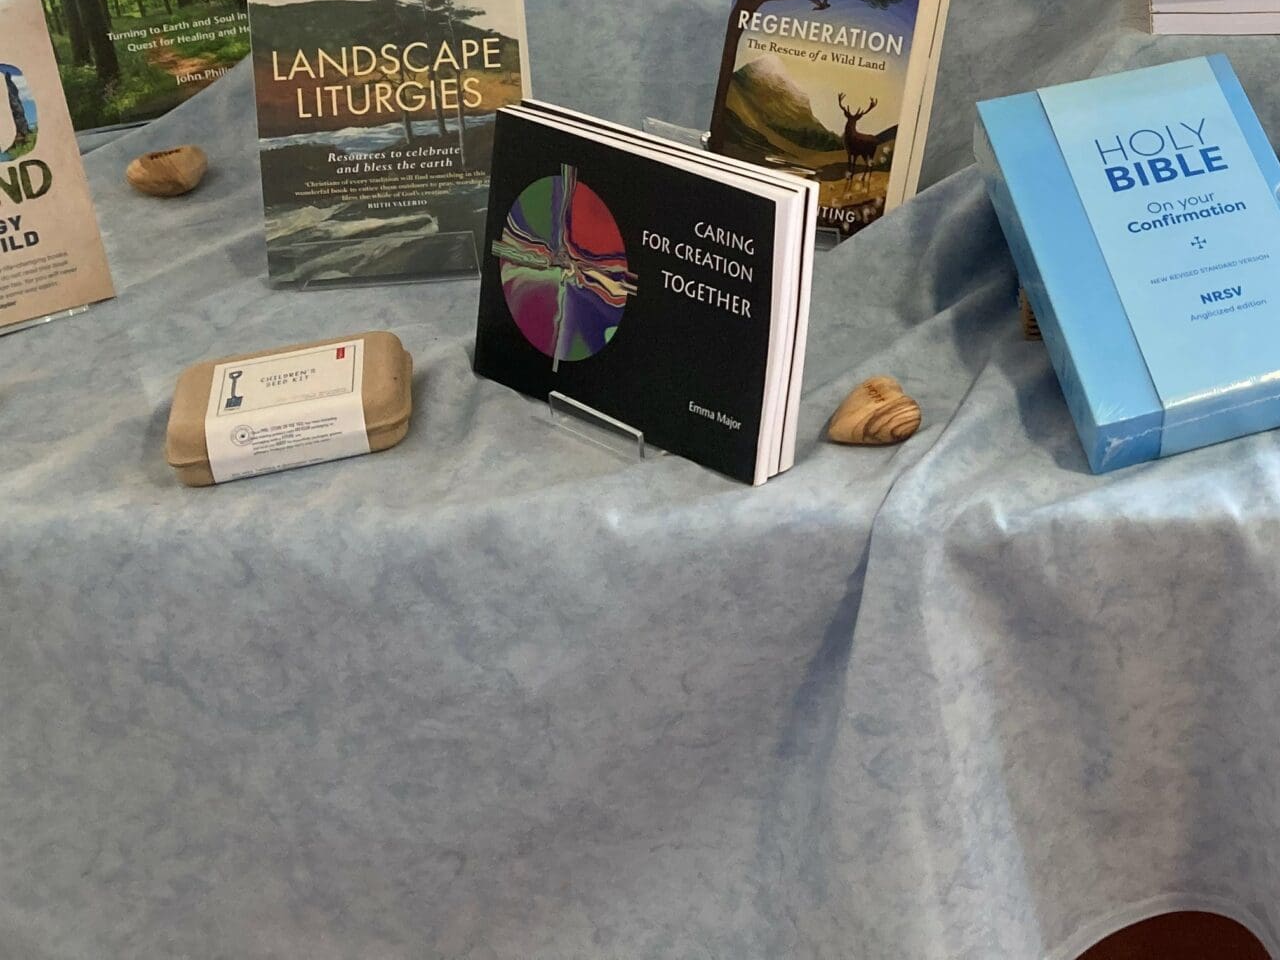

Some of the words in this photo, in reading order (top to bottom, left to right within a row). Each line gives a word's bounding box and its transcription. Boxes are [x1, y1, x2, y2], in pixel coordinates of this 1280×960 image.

[738, 10, 903, 55] REGENERATION
[273, 38, 500, 81] LANDSCAPE
[747, 38, 766, 51] The
[769, 42, 806, 58] Rescue
[809, 48, 820, 61] of
[821, 52, 827, 61] a
[831, 52, 855, 66] Wild
[858, 57, 885, 71] Land
[298, 78, 482, 118] LITURGIES
[328, 150, 386, 163] Resources
[390, 149, 399, 158] to
[402, 146, 461, 157] celebrate
[1095, 118, 1206, 165] HOLY
[336, 163, 360, 174] and
[364, 161, 392, 172] bless
[397, 159, 415, 170] the
[417, 158, 452, 168] earth
[1104, 146, 1228, 192] BIBLE
[1127, 199, 1246, 234] Confirmation
[1147, 200, 1173, 214] On
[1177, 191, 1215, 210] your
[642, 230, 670, 255] FOR
[675, 243, 753, 282] CREATION
[694, 221, 754, 256] CARING
[661, 270, 751, 318] TOGETHER
[1200, 286, 1243, 305] NRSV
[689, 401, 715, 420] Emma
[717, 411, 741, 431] Major
